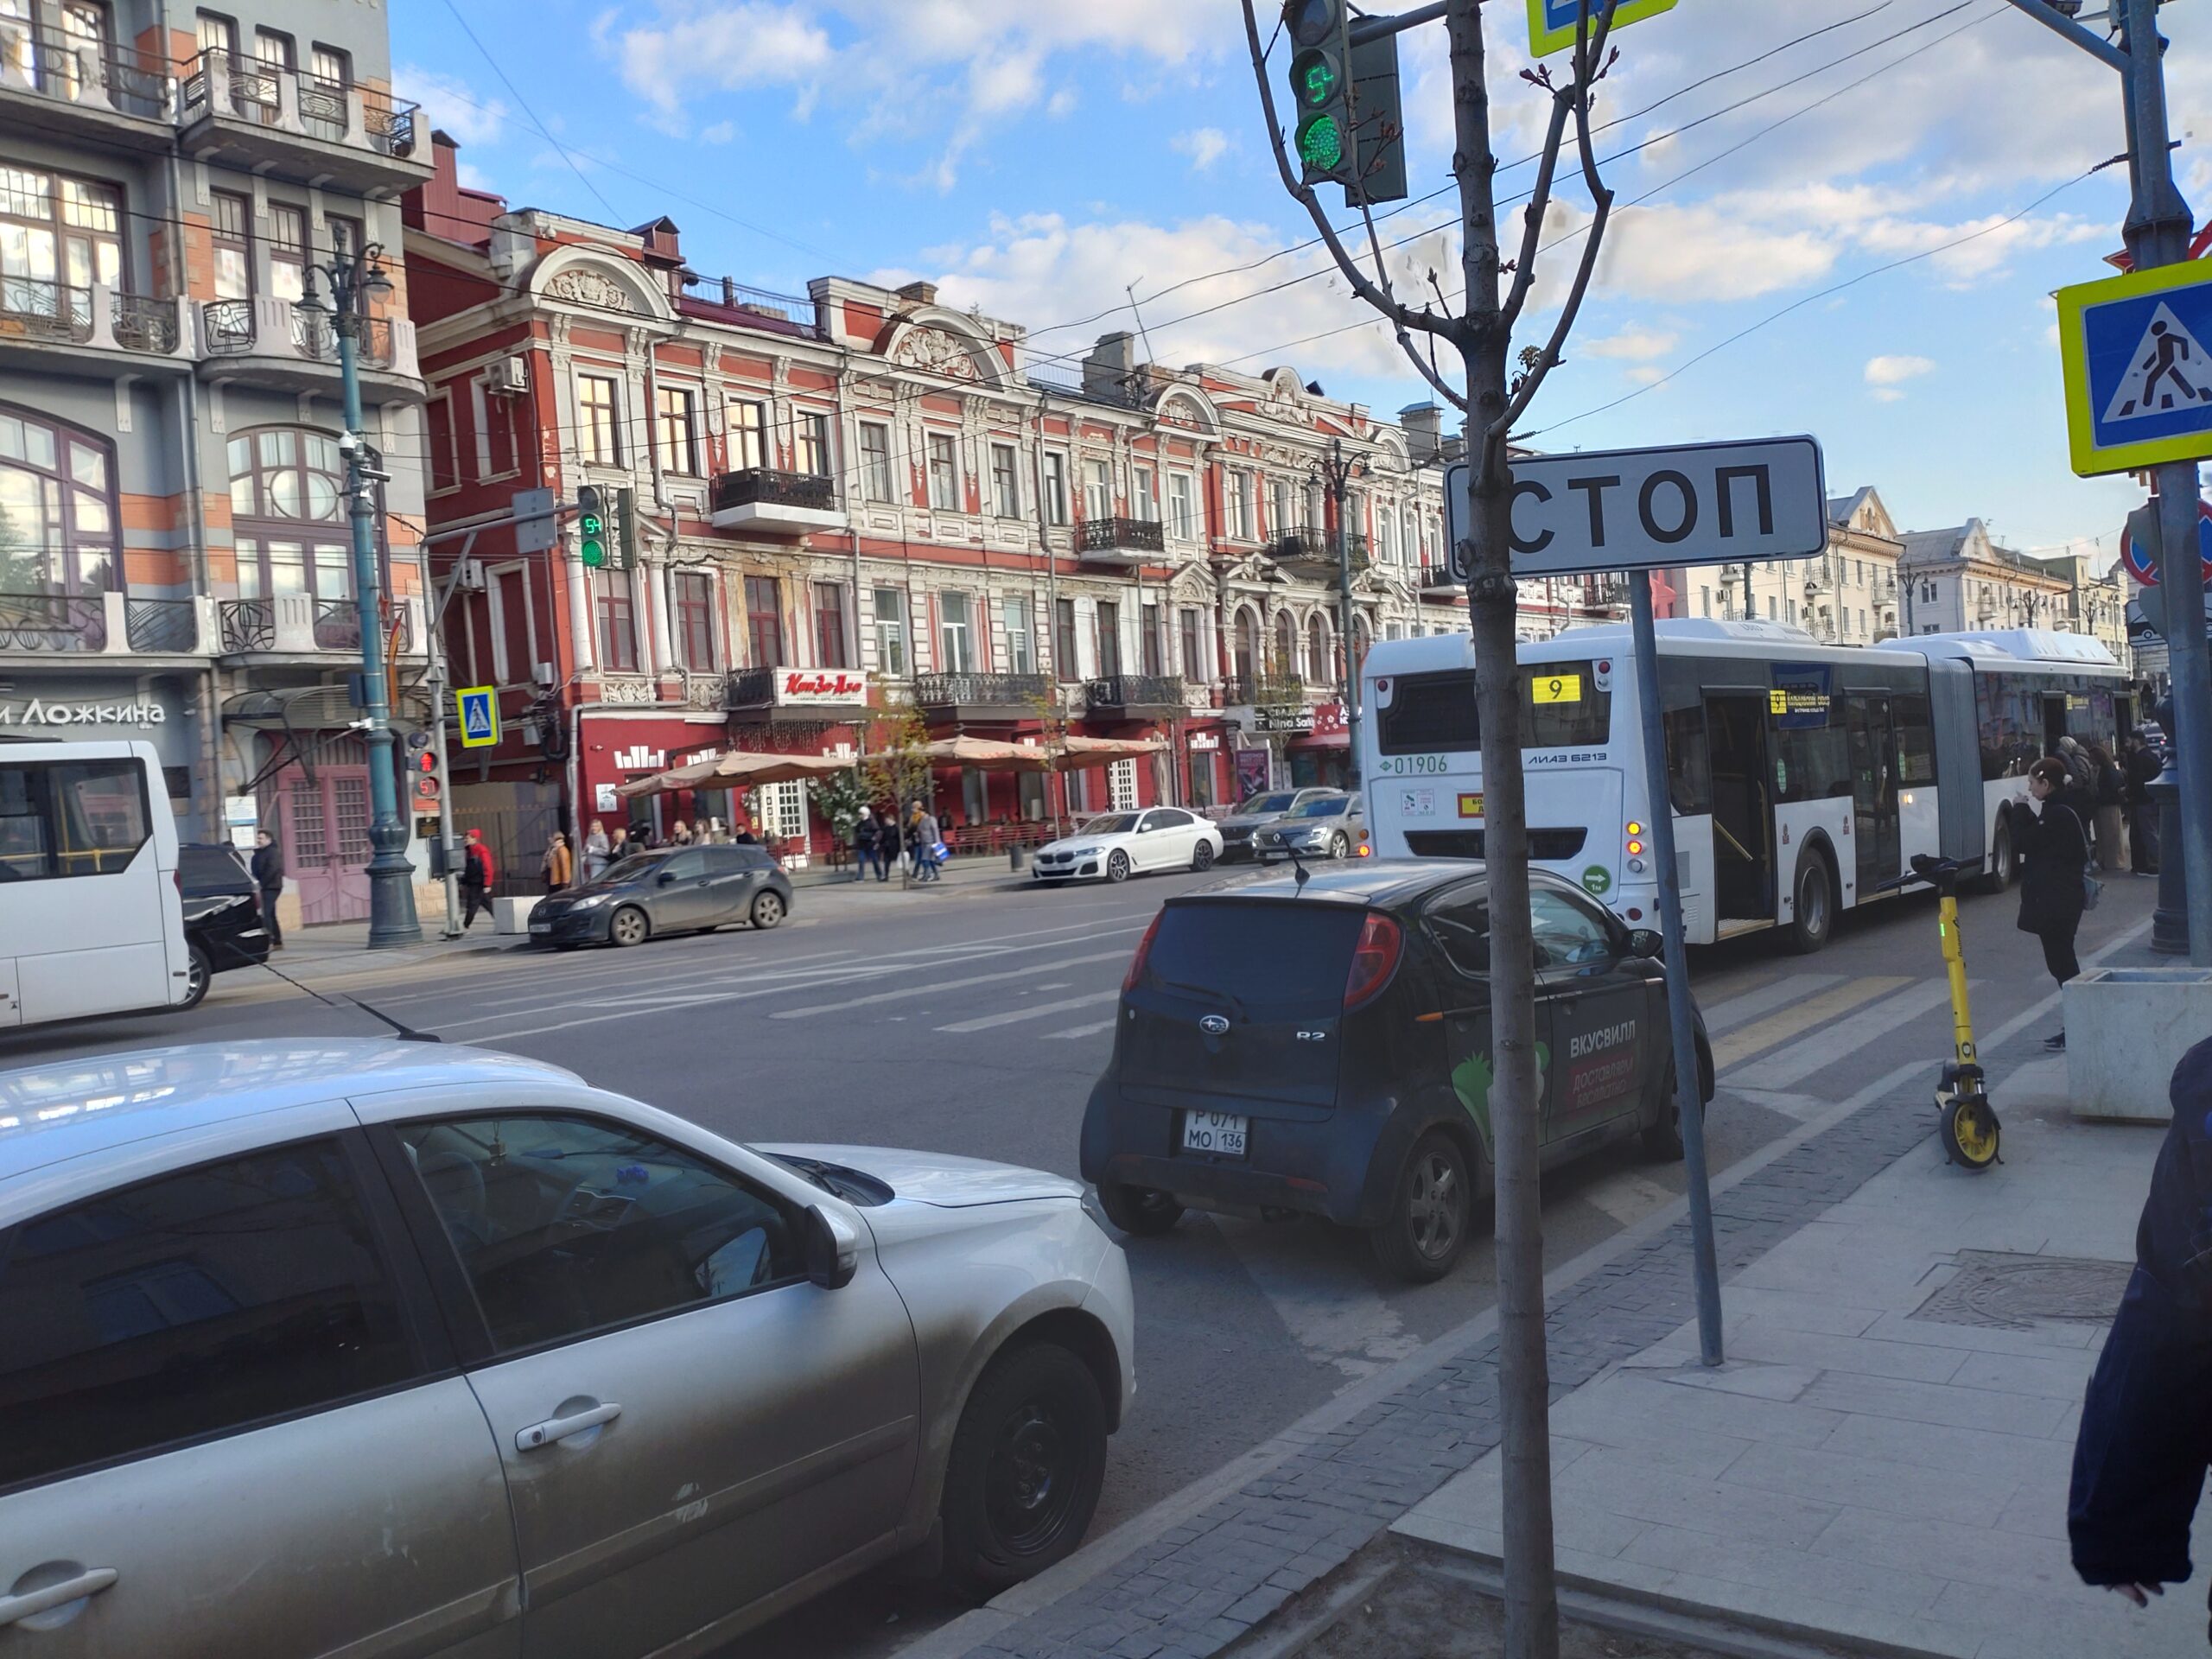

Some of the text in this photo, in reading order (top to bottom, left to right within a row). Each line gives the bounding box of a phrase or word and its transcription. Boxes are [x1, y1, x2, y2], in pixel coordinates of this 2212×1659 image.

[1509, 463, 1775, 554] СТОП
[584, 518, 601, 534] 54
[1549, 679, 1562, 700] 9
[22, 697, 166, 724] Ложкина
[1395, 754, 1447, 774] 01906
[1529, 753, 1607, 765] ЛИАЗ 6213
[1297, 1031, 1325, 1041] R2
[1570, 1020, 1636, 1058] ВКУСВИЛЛ
[1188, 1129, 1243, 1148] МО 136
